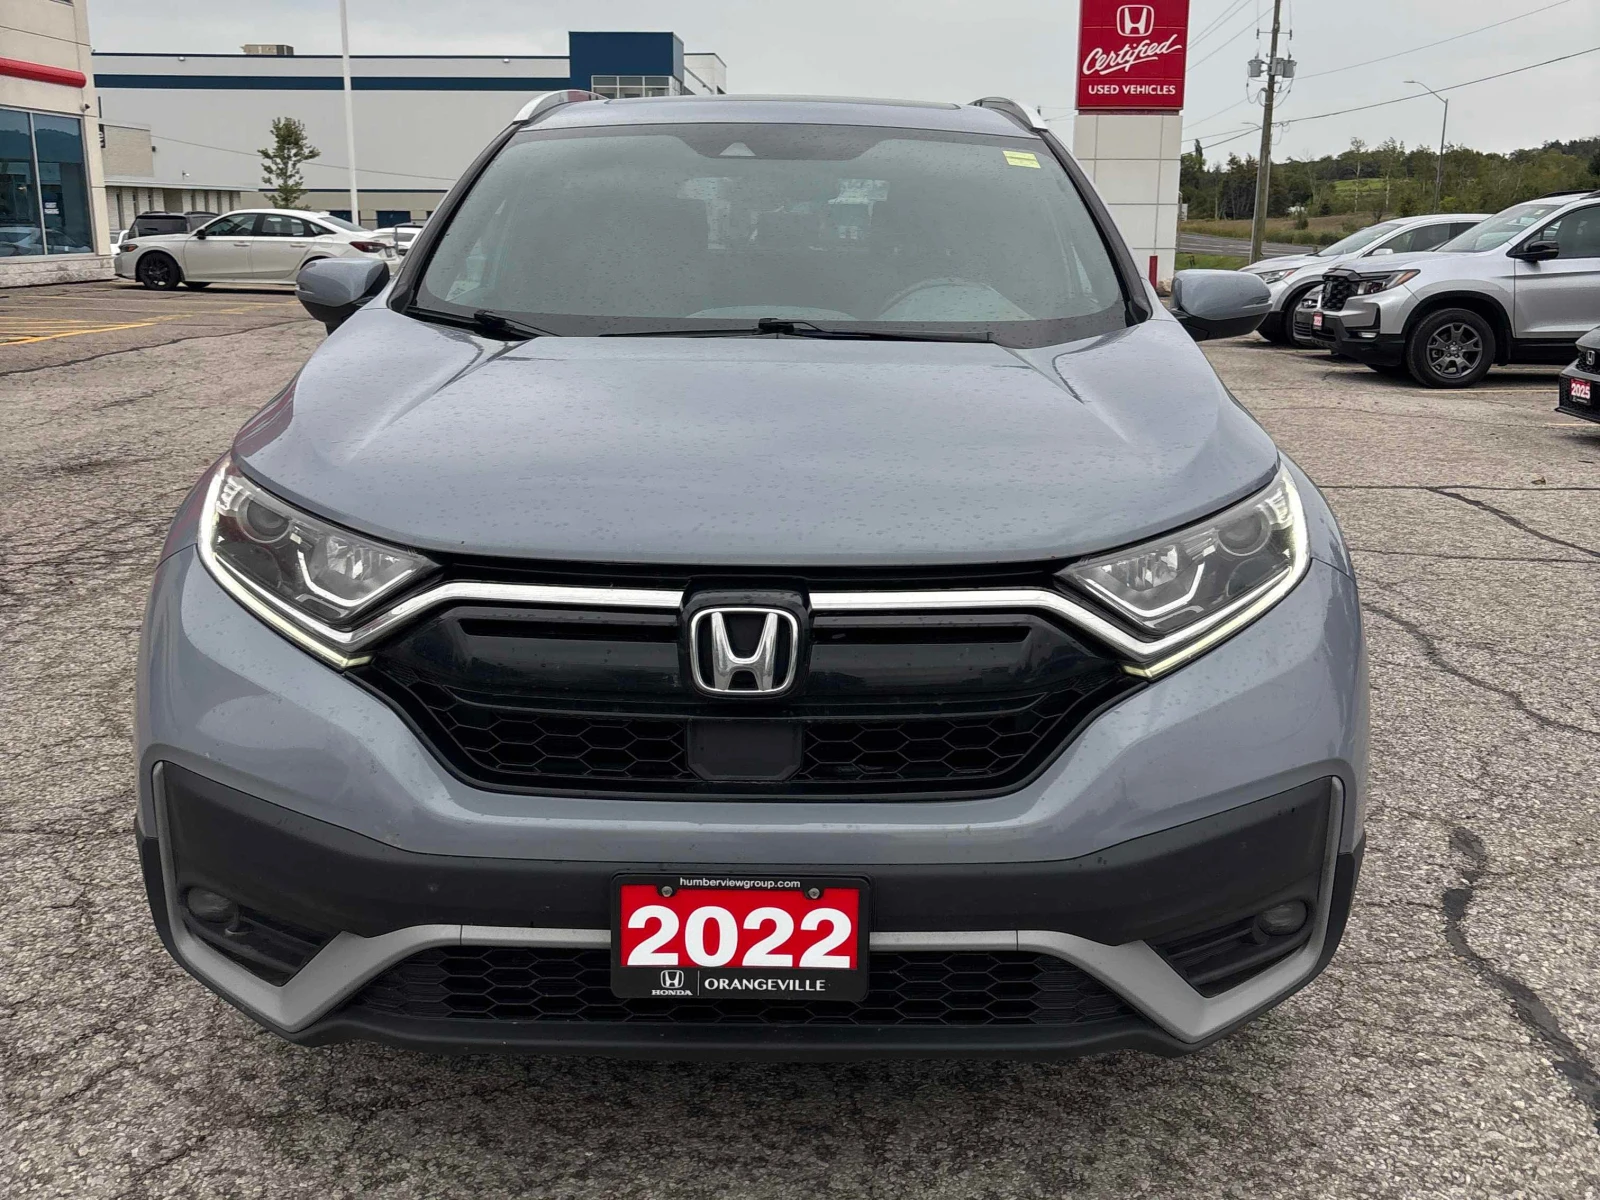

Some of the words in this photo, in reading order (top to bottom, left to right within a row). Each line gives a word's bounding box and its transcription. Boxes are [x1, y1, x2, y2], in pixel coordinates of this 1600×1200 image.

[1082, 34, 1182, 75] Certified
[1088, 85, 1119, 94] USED
[1122, 85, 1176, 94] VEHICLES
[1571, 383, 1590, 399] 2025
[680, 877, 800, 889] humberviewgroup.com
[627, 905, 852, 969] 2022
[704, 978, 826, 991] ORANGEVILLE
